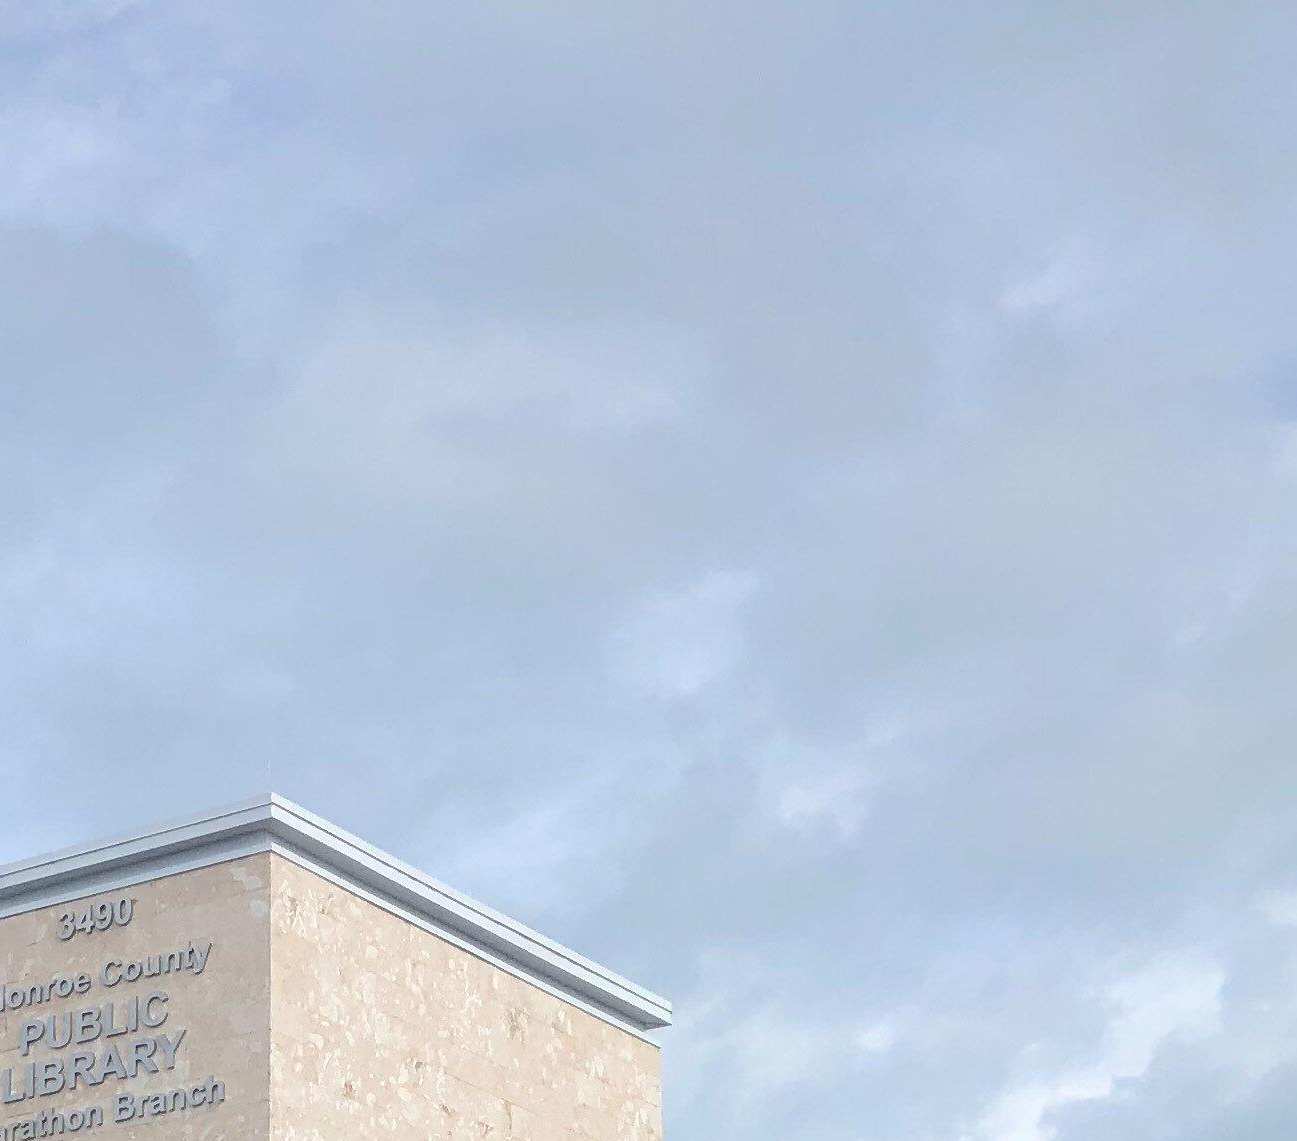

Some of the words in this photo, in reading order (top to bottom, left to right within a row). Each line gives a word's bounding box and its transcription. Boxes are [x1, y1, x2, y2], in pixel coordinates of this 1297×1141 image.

[56, 898, 137, 941] 3490
[99, 941, 212, 987] County
[19, 990, 170, 1057] PUBLIC
[0, 1029, 187, 1105] LIBRARY
[111, 1076, 226, 1124] Branch
